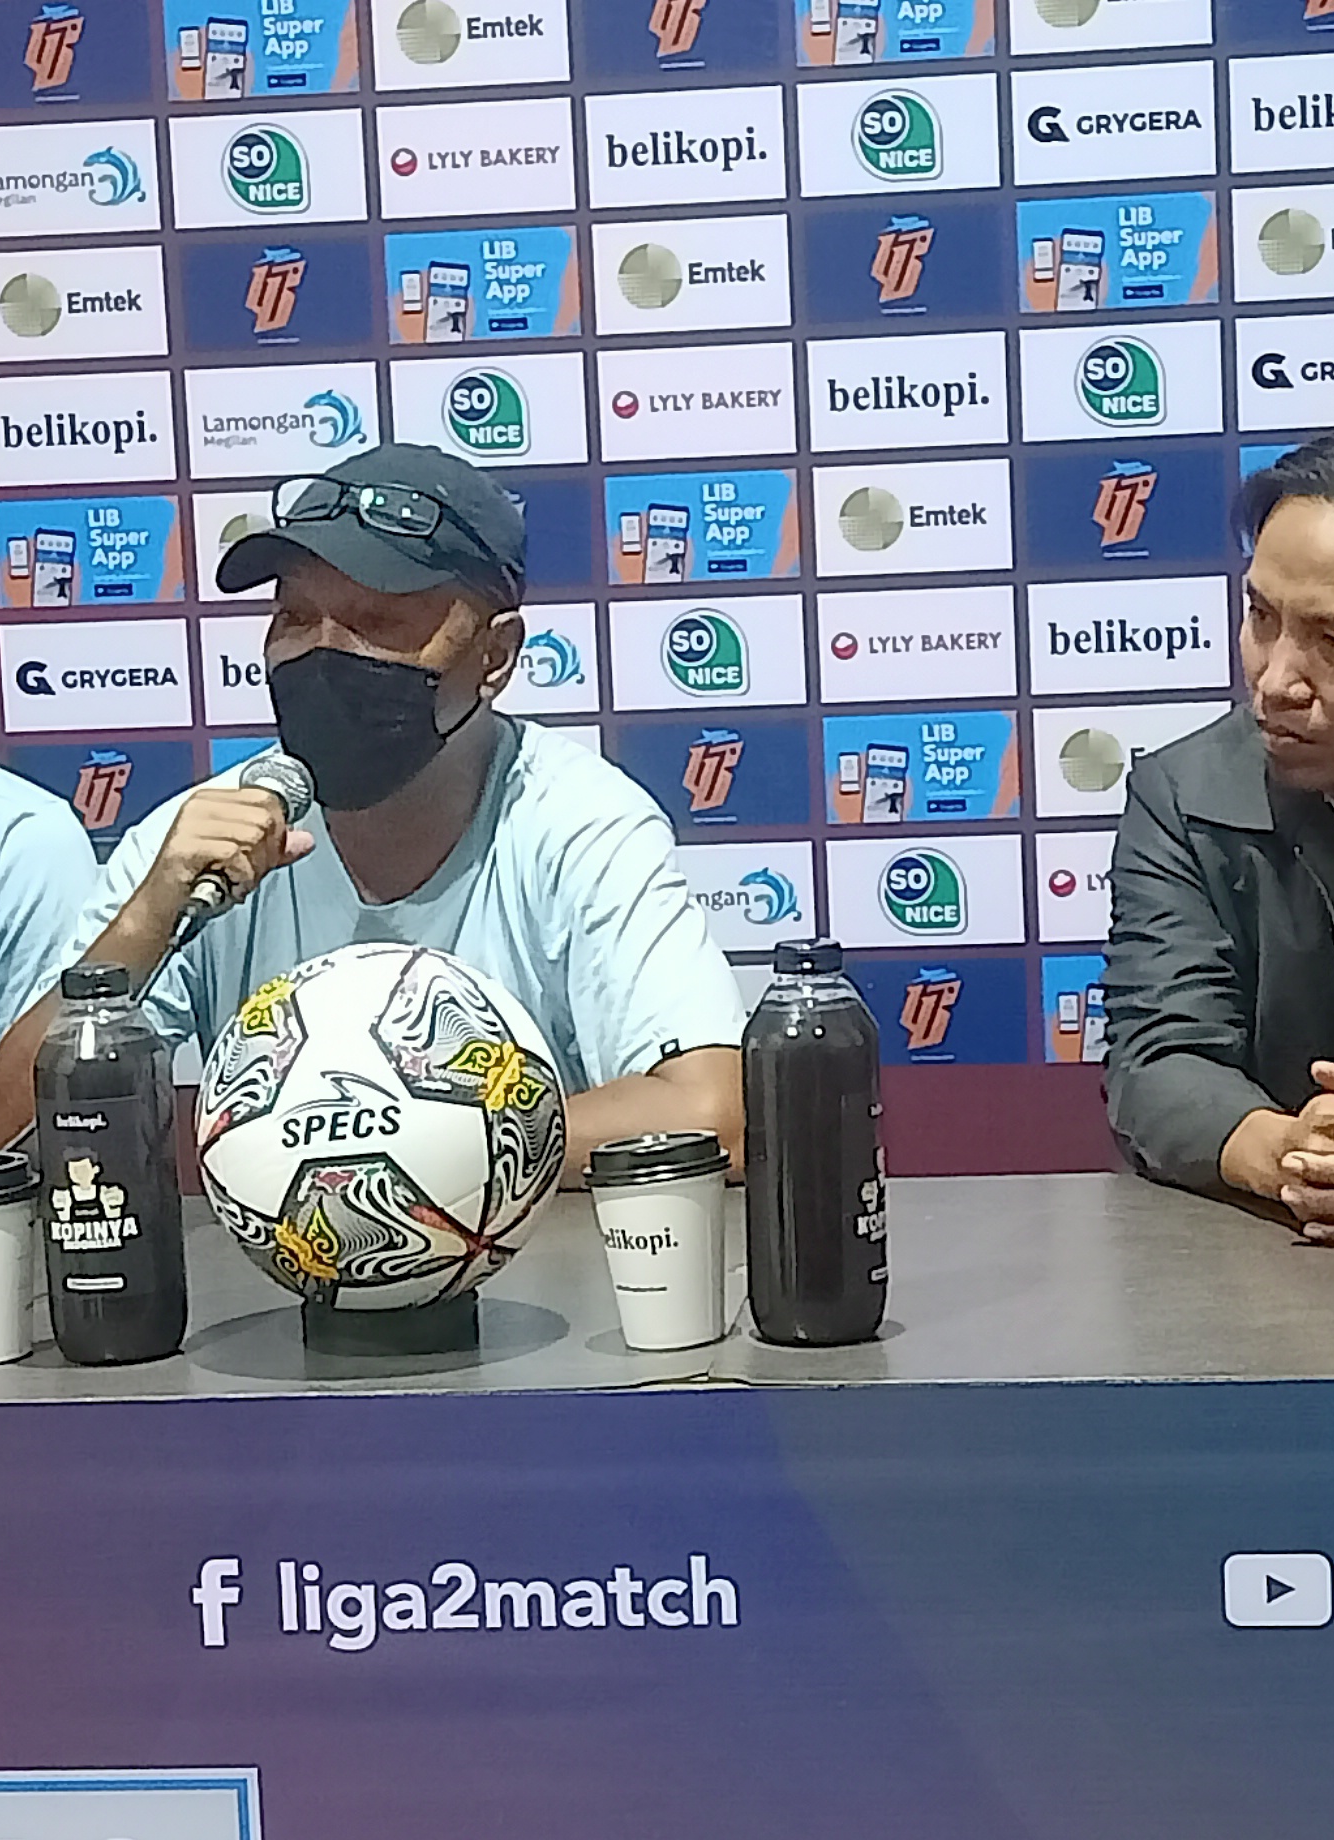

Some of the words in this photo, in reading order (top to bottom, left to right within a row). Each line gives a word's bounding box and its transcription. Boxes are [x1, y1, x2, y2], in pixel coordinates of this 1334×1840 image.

[264, 17, 324, 38] Super
[467, 14, 543, 39] Emtek
[265, 38, 308, 59] App
[864, 111, 902, 134] SO
[1077, 110, 1202, 134] GRYGERA
[233, 145, 270, 167] SO
[428, 150, 472, 170] LYLY
[480, 146, 560, 167] BAKERY
[606, 127, 766, 171] belikopi.
[879, 149, 933, 168] NICE
[249, 183, 300, 201] NICE
[1119, 207, 1152, 226] LIB
[1120, 228, 1183, 249] Super
[483, 241, 516, 259] LIB
[1121, 249, 1166, 270] App
[485, 262, 546, 283] Super
[689, 259, 765, 284] Emtek
[67, 289, 142, 313] Emtek
[486, 281, 530, 304] App
[1087, 357, 1126, 379] SO
[449, 388, 490, 410] SO
[650, 394, 694, 412] LYLY
[702, 389, 781, 409] BAKERY
[828, 372, 989, 417] belikopi.
[1103, 395, 1156, 413] NICE
[1, 411, 157, 454] belikopi.
[202, 413, 315, 434] Lamongan
[469, 425, 521, 443] NICE
[703, 483, 735, 501] LIB
[88, 509, 120, 527] LIB
[704, 504, 765, 525] Super
[910, 503, 986, 527] Emtek
[89, 529, 149, 550] Super
[706, 523, 749, 545] App
[92, 548, 134, 569] App
[673, 630, 710, 652] SO
[869, 635, 913, 653] LYLY
[921, 632, 1001, 652] BAKERY
[1048, 616, 1210, 659] belikopi.
[62, 667, 178, 688] GRYGERA
[688, 667, 740, 684] NICE
[922, 724, 955, 742] LIB
[923, 744, 985, 765] Super
[925, 764, 968, 785] App
[890, 869, 927, 889] SO
[906, 905, 957, 922] NICE
[282, 1104, 401, 1148] SPECS
[51, 1217, 138, 1241] KOPINYA
[278, 1553, 741, 1652] liga2match
